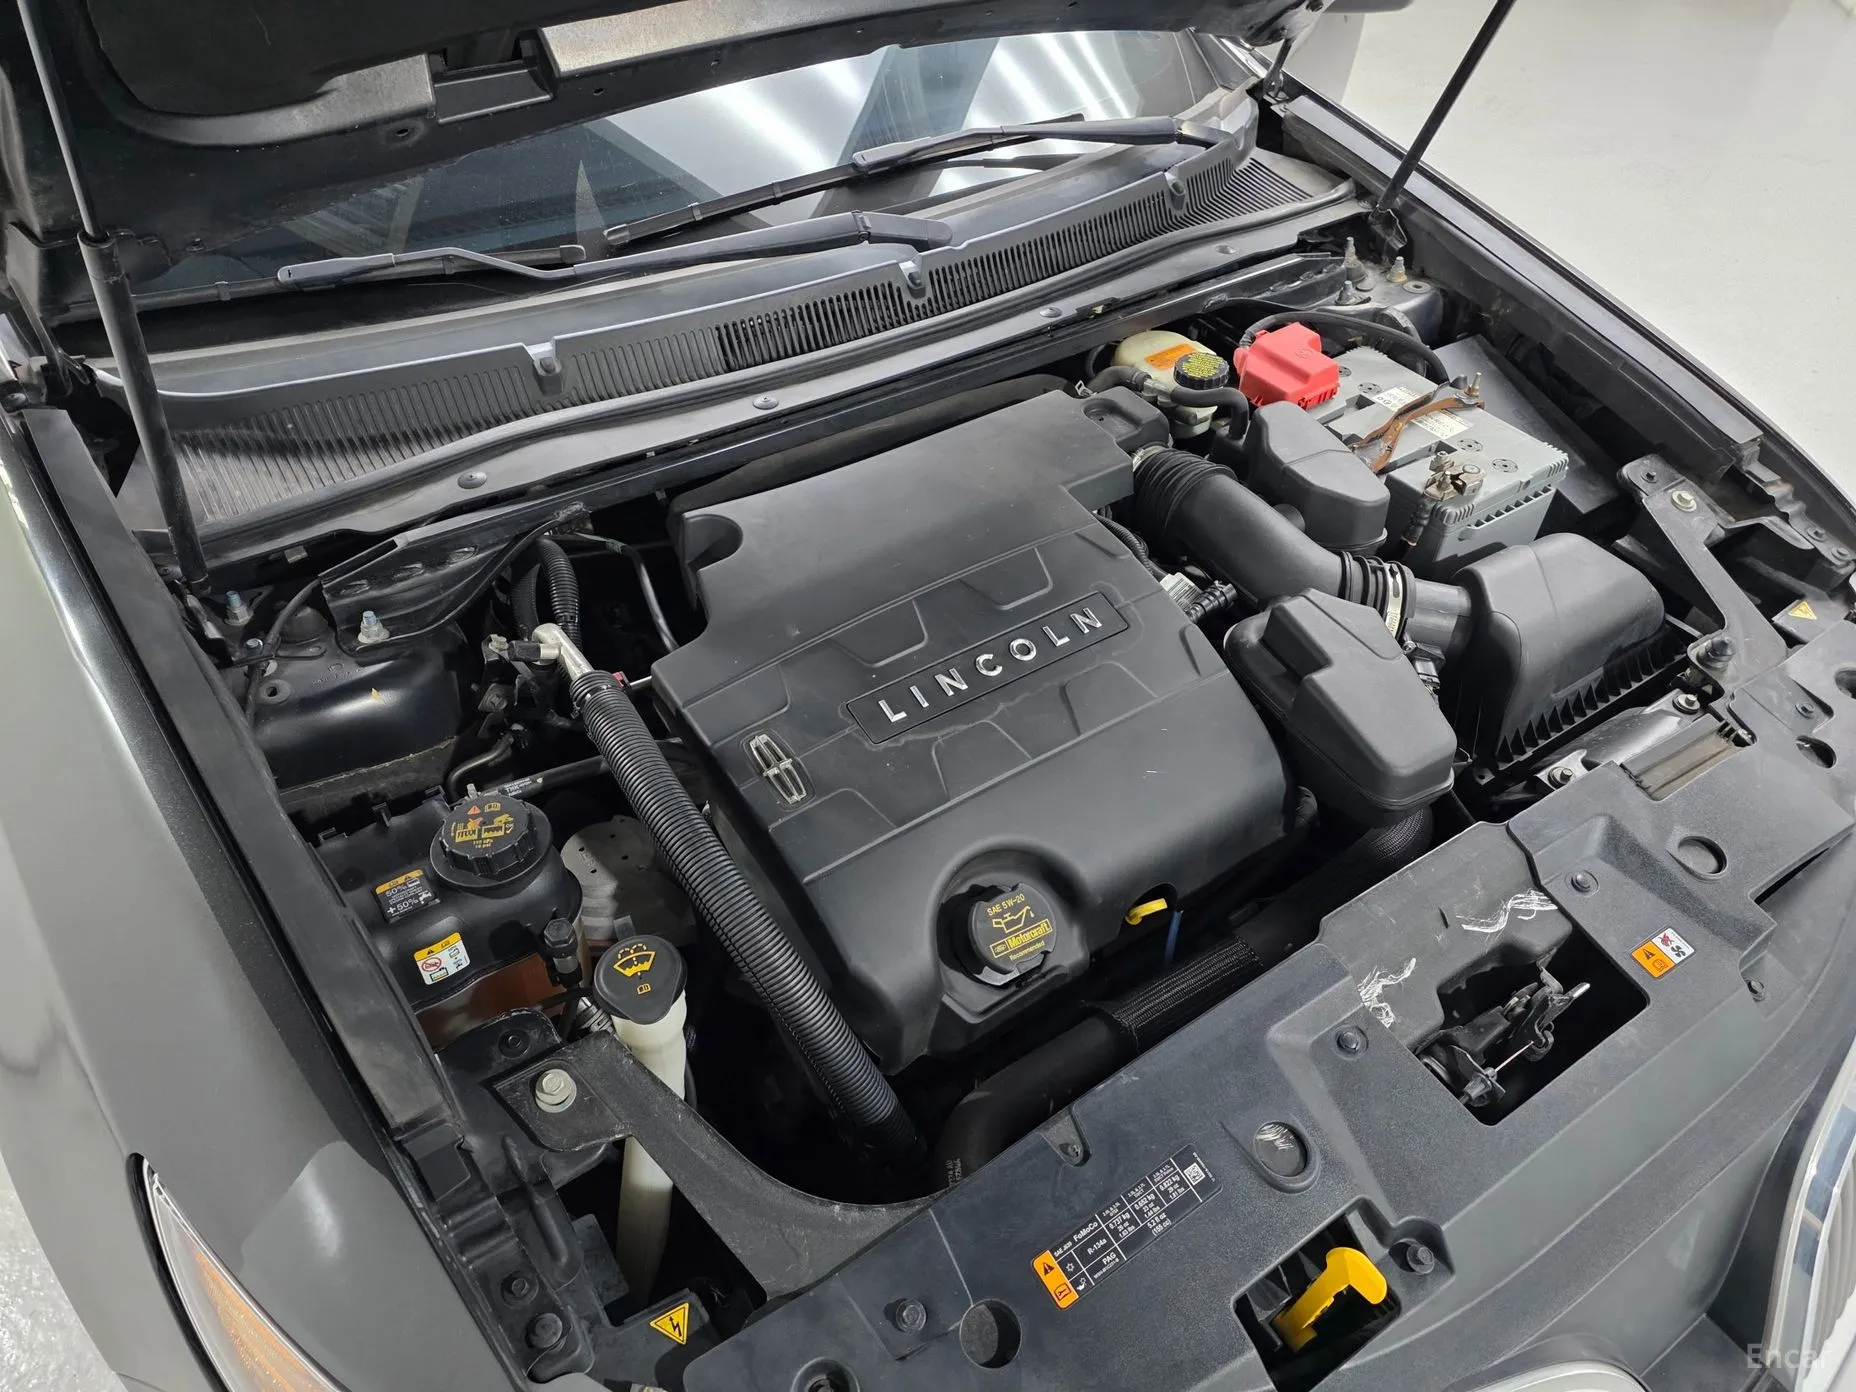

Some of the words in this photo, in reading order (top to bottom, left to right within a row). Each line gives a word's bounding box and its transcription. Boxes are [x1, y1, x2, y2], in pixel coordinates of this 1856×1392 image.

[878, 607, 1103, 722] LINCOLN
[987, 904, 1002, 916] SAE
[1002, 893, 1025, 909] 5W-20
[1007, 922, 1049, 949] Motorcraft
[1009, 940, 1045, 960] Recommended
[1171, 1174, 1180, 1182] kg
[1146, 1193, 1156, 1201] kg
[1108, 1216, 1123, 1229] 0.737
[1121, 1212, 1131, 1220] kg
[1147, 1218, 1157, 1228] 5.2
[1159, 1212, 1167, 1220] oz
[1152, 1223, 1164, 1237] (155
[1162, 1217, 1172, 1228] cc)
[1073, 1221, 1098, 1242] FoMoCo
[1087, 1238, 1107, 1255] R-134a
[1102, 1251, 1117, 1265] PAG
